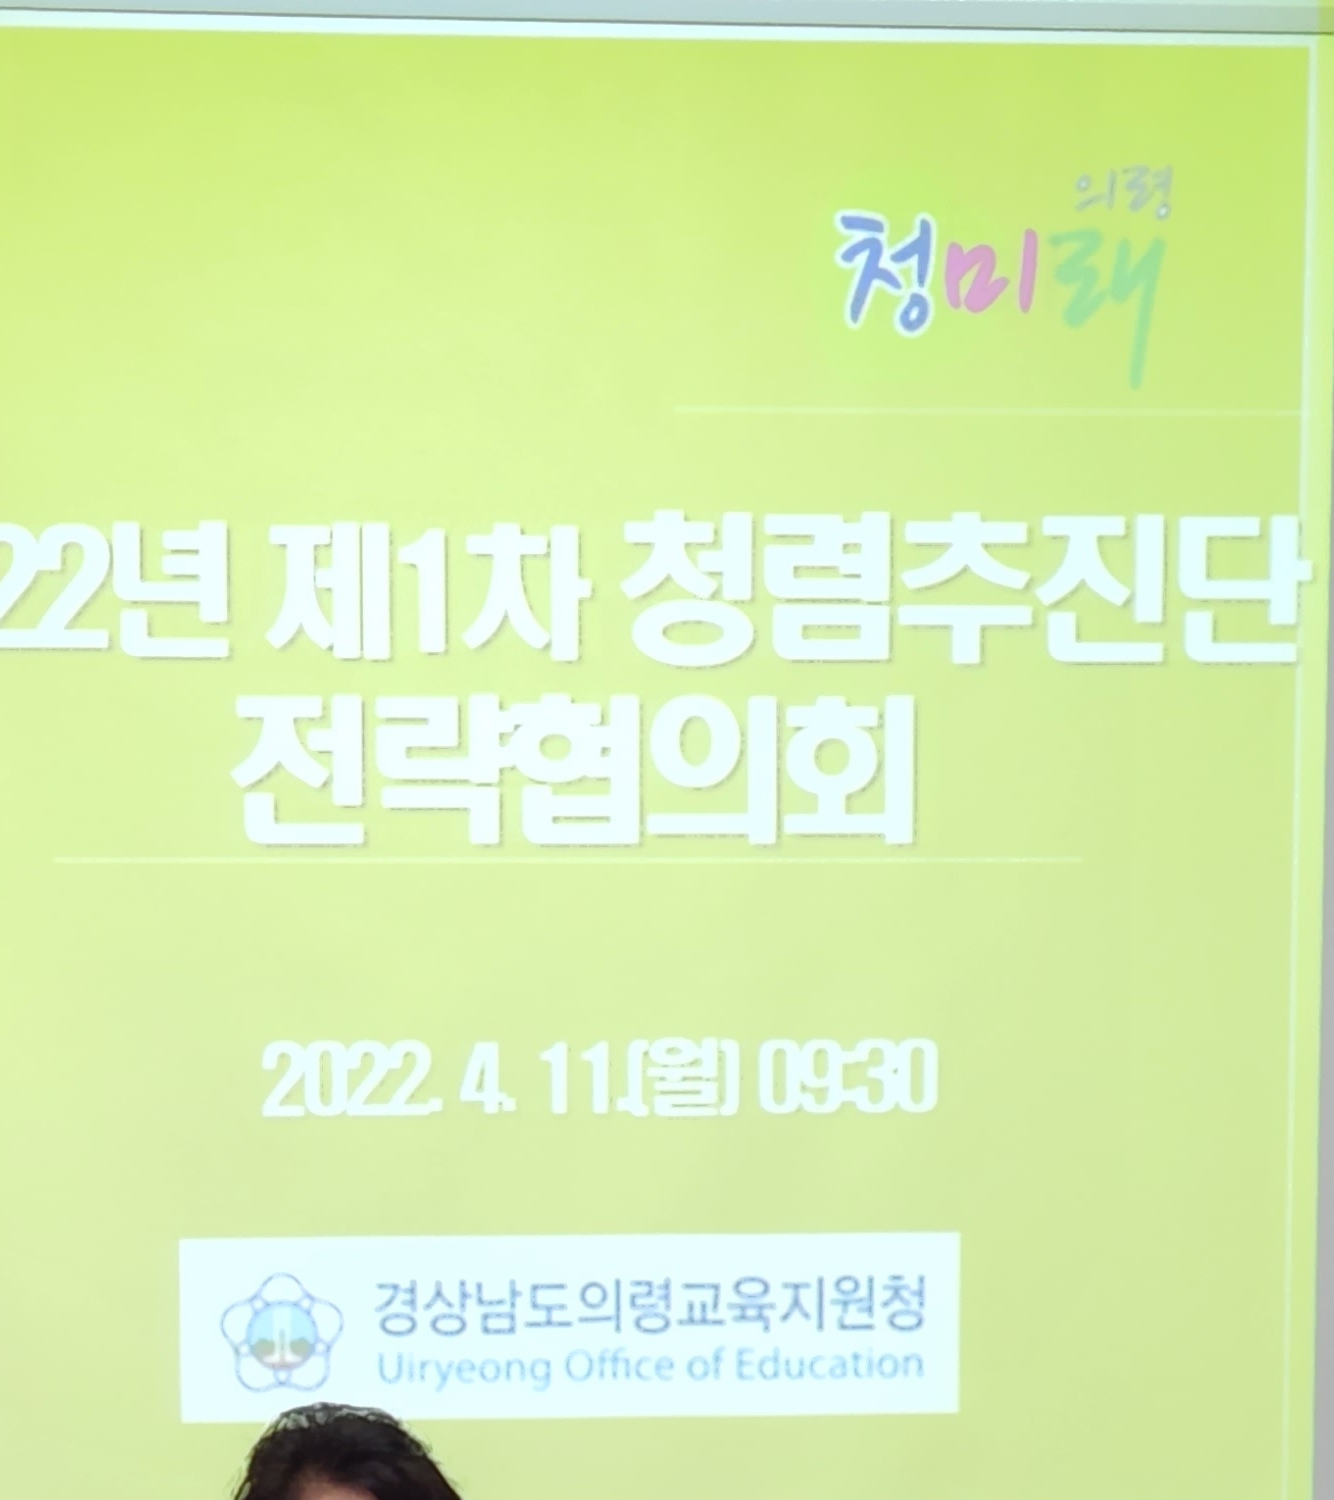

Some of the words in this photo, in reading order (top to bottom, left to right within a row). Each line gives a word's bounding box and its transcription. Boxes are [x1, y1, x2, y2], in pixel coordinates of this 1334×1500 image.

[1074, 163, 1174, 221] 의령
[834, 210, 1166, 390] 청미래
[267, 520, 592, 660] 제1차
[622, 509, 1313, 667] 청렴추진단
[232, 692, 916, 846] 전략협의회
[261, 1039, 443, 1117] 2022.
[459, 1041, 516, 1114] 4.
[759, 1038, 938, 1113] 09:30
[373, 1275, 927, 1338] 경상남도의령교육지원청
[378, 1352, 552, 1392] Uiryeong
[566, 1346, 675, 1383] Office
[685, 1345, 726, 1382] of
[736, 1345, 924, 1381] Education
